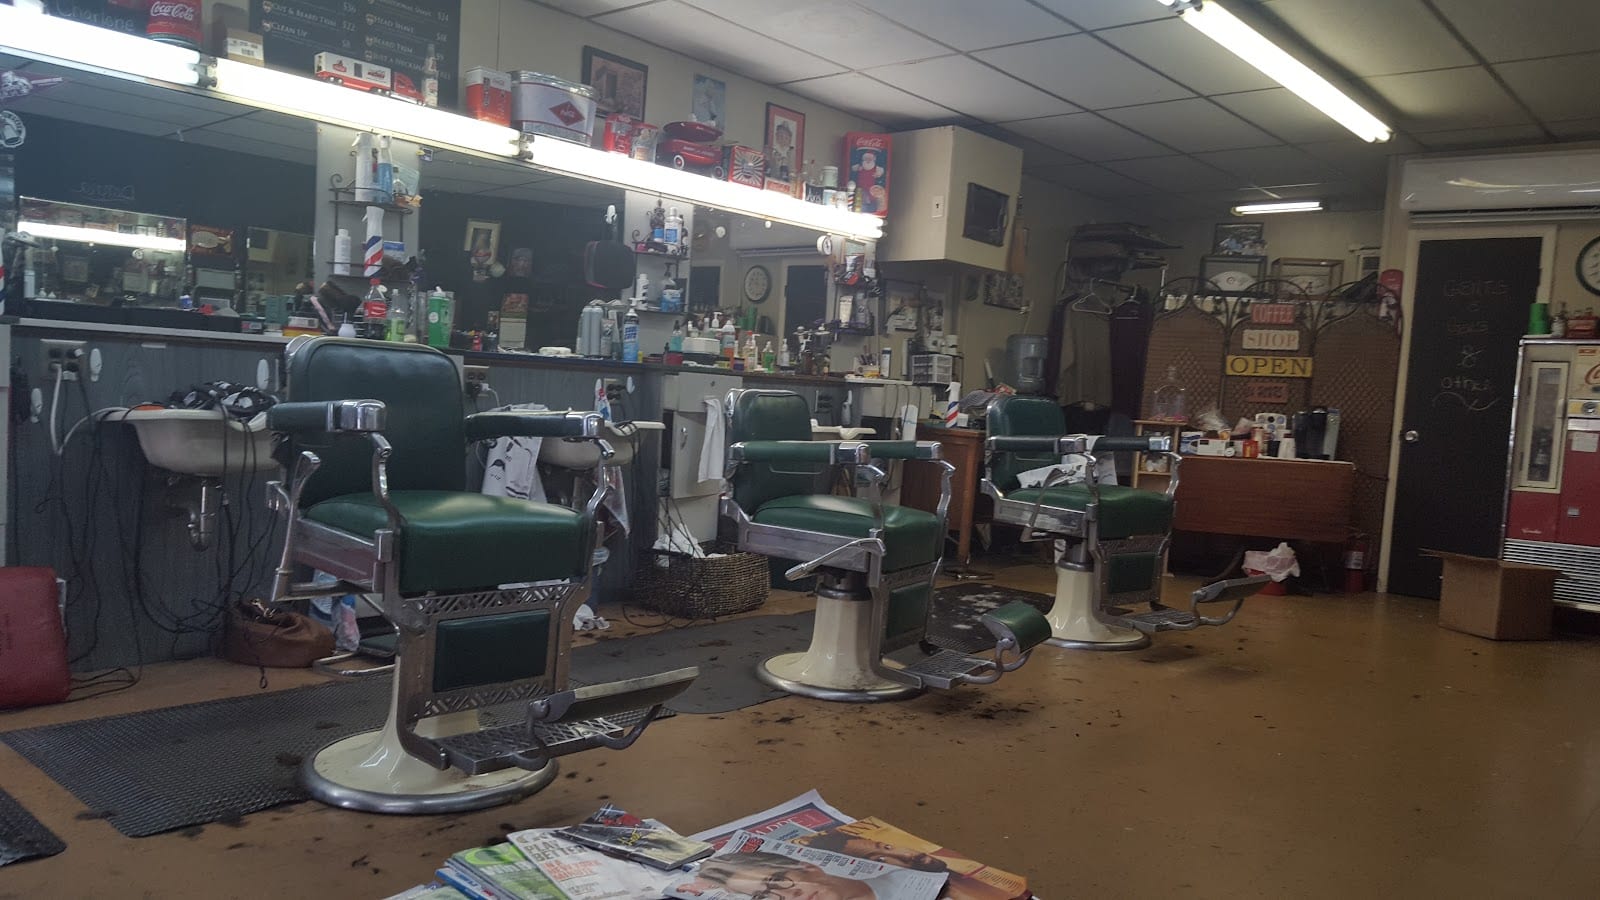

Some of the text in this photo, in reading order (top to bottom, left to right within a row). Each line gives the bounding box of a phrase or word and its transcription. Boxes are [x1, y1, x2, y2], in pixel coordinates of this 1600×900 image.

[1252, 304, 1294, 322] COFFEE
[1247, 333, 1296, 347] SHOP
[1230, 357, 1309, 375] OPEN
